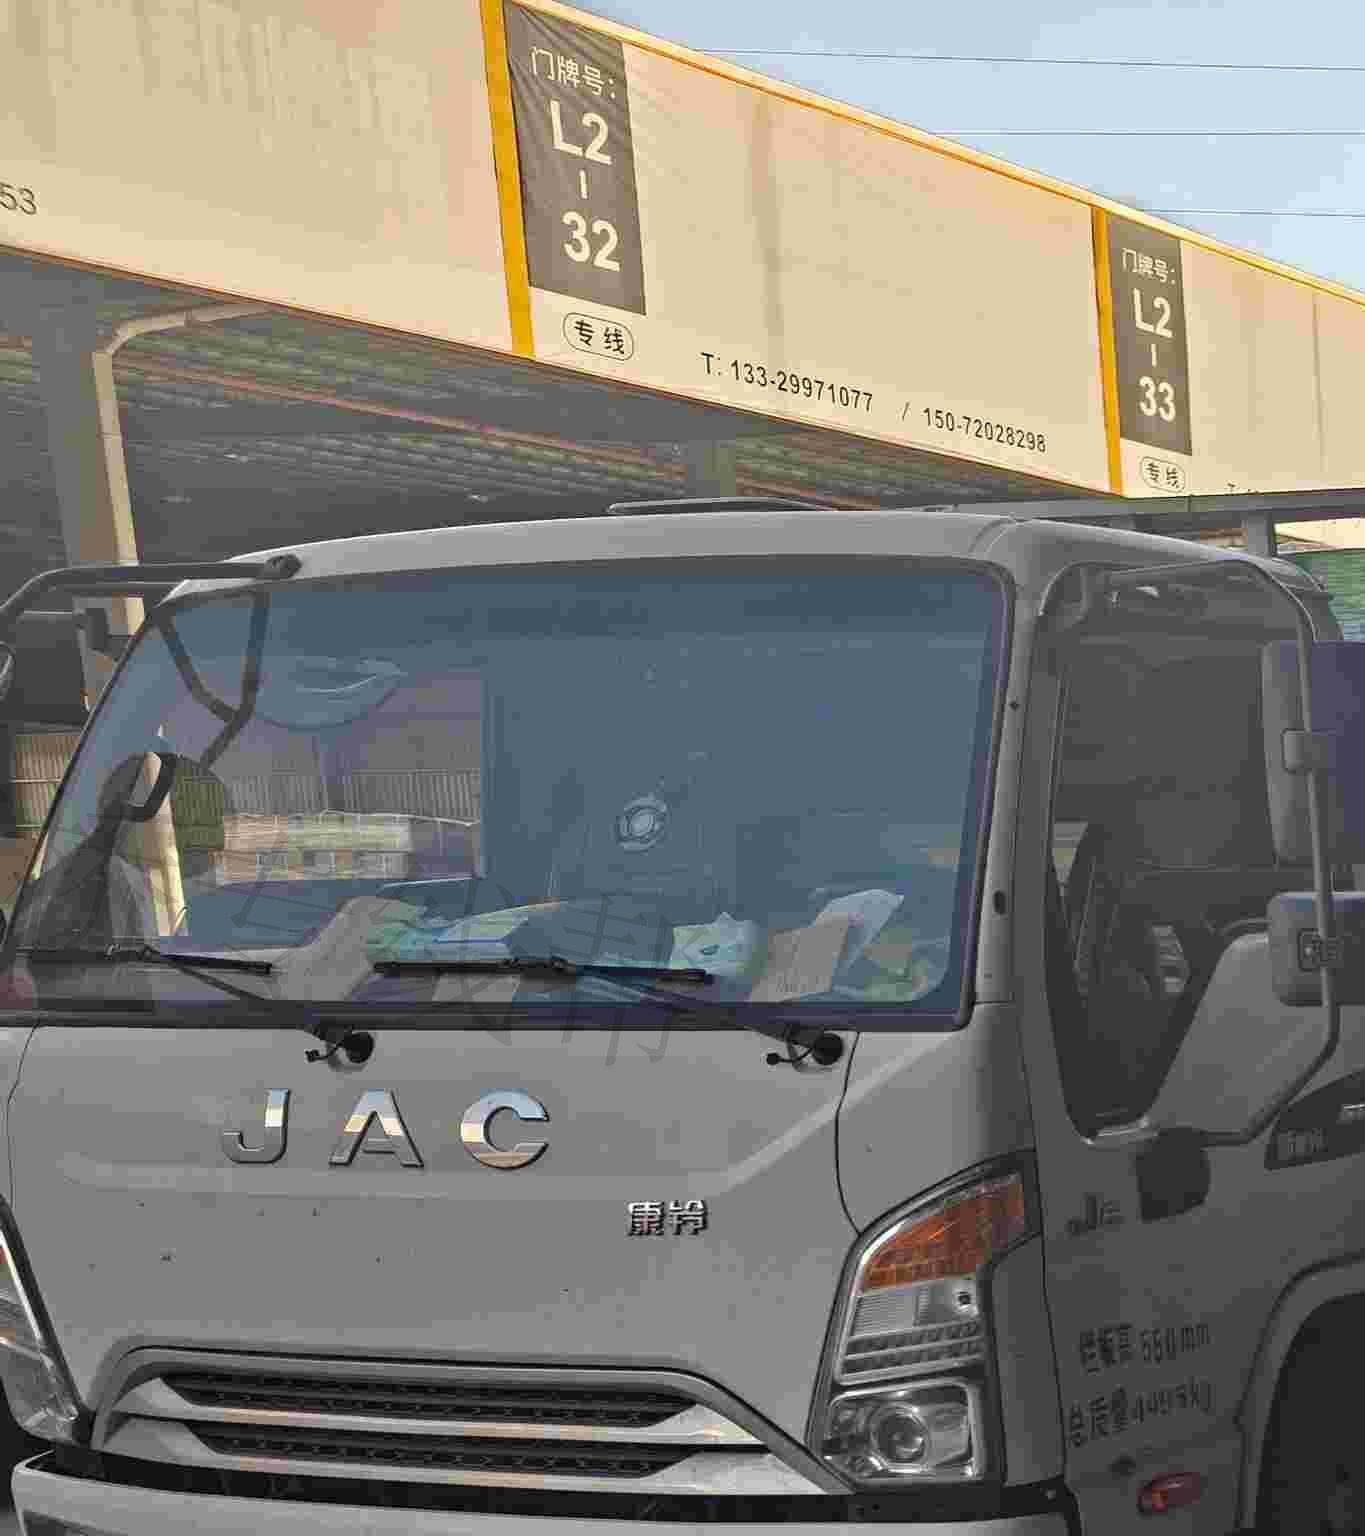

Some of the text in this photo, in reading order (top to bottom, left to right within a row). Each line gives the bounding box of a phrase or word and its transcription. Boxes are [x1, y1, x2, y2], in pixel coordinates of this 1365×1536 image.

[531, 45, 616, 100] 门牌号:
[550, 99, 613, 166] L2
[562, 209, 621, 273] 32
[573, 319, 627, 356] 专线
[1132, 287, 1174, 338] L2
[700, 352, 724, 378] T:
[729, 358, 873, 414] 133-29971077
[922, 406, 1048, 455] 150-72028298
[1139, 375, 1177, 423] 33
[222, 1087, 552, 1170] JAC
